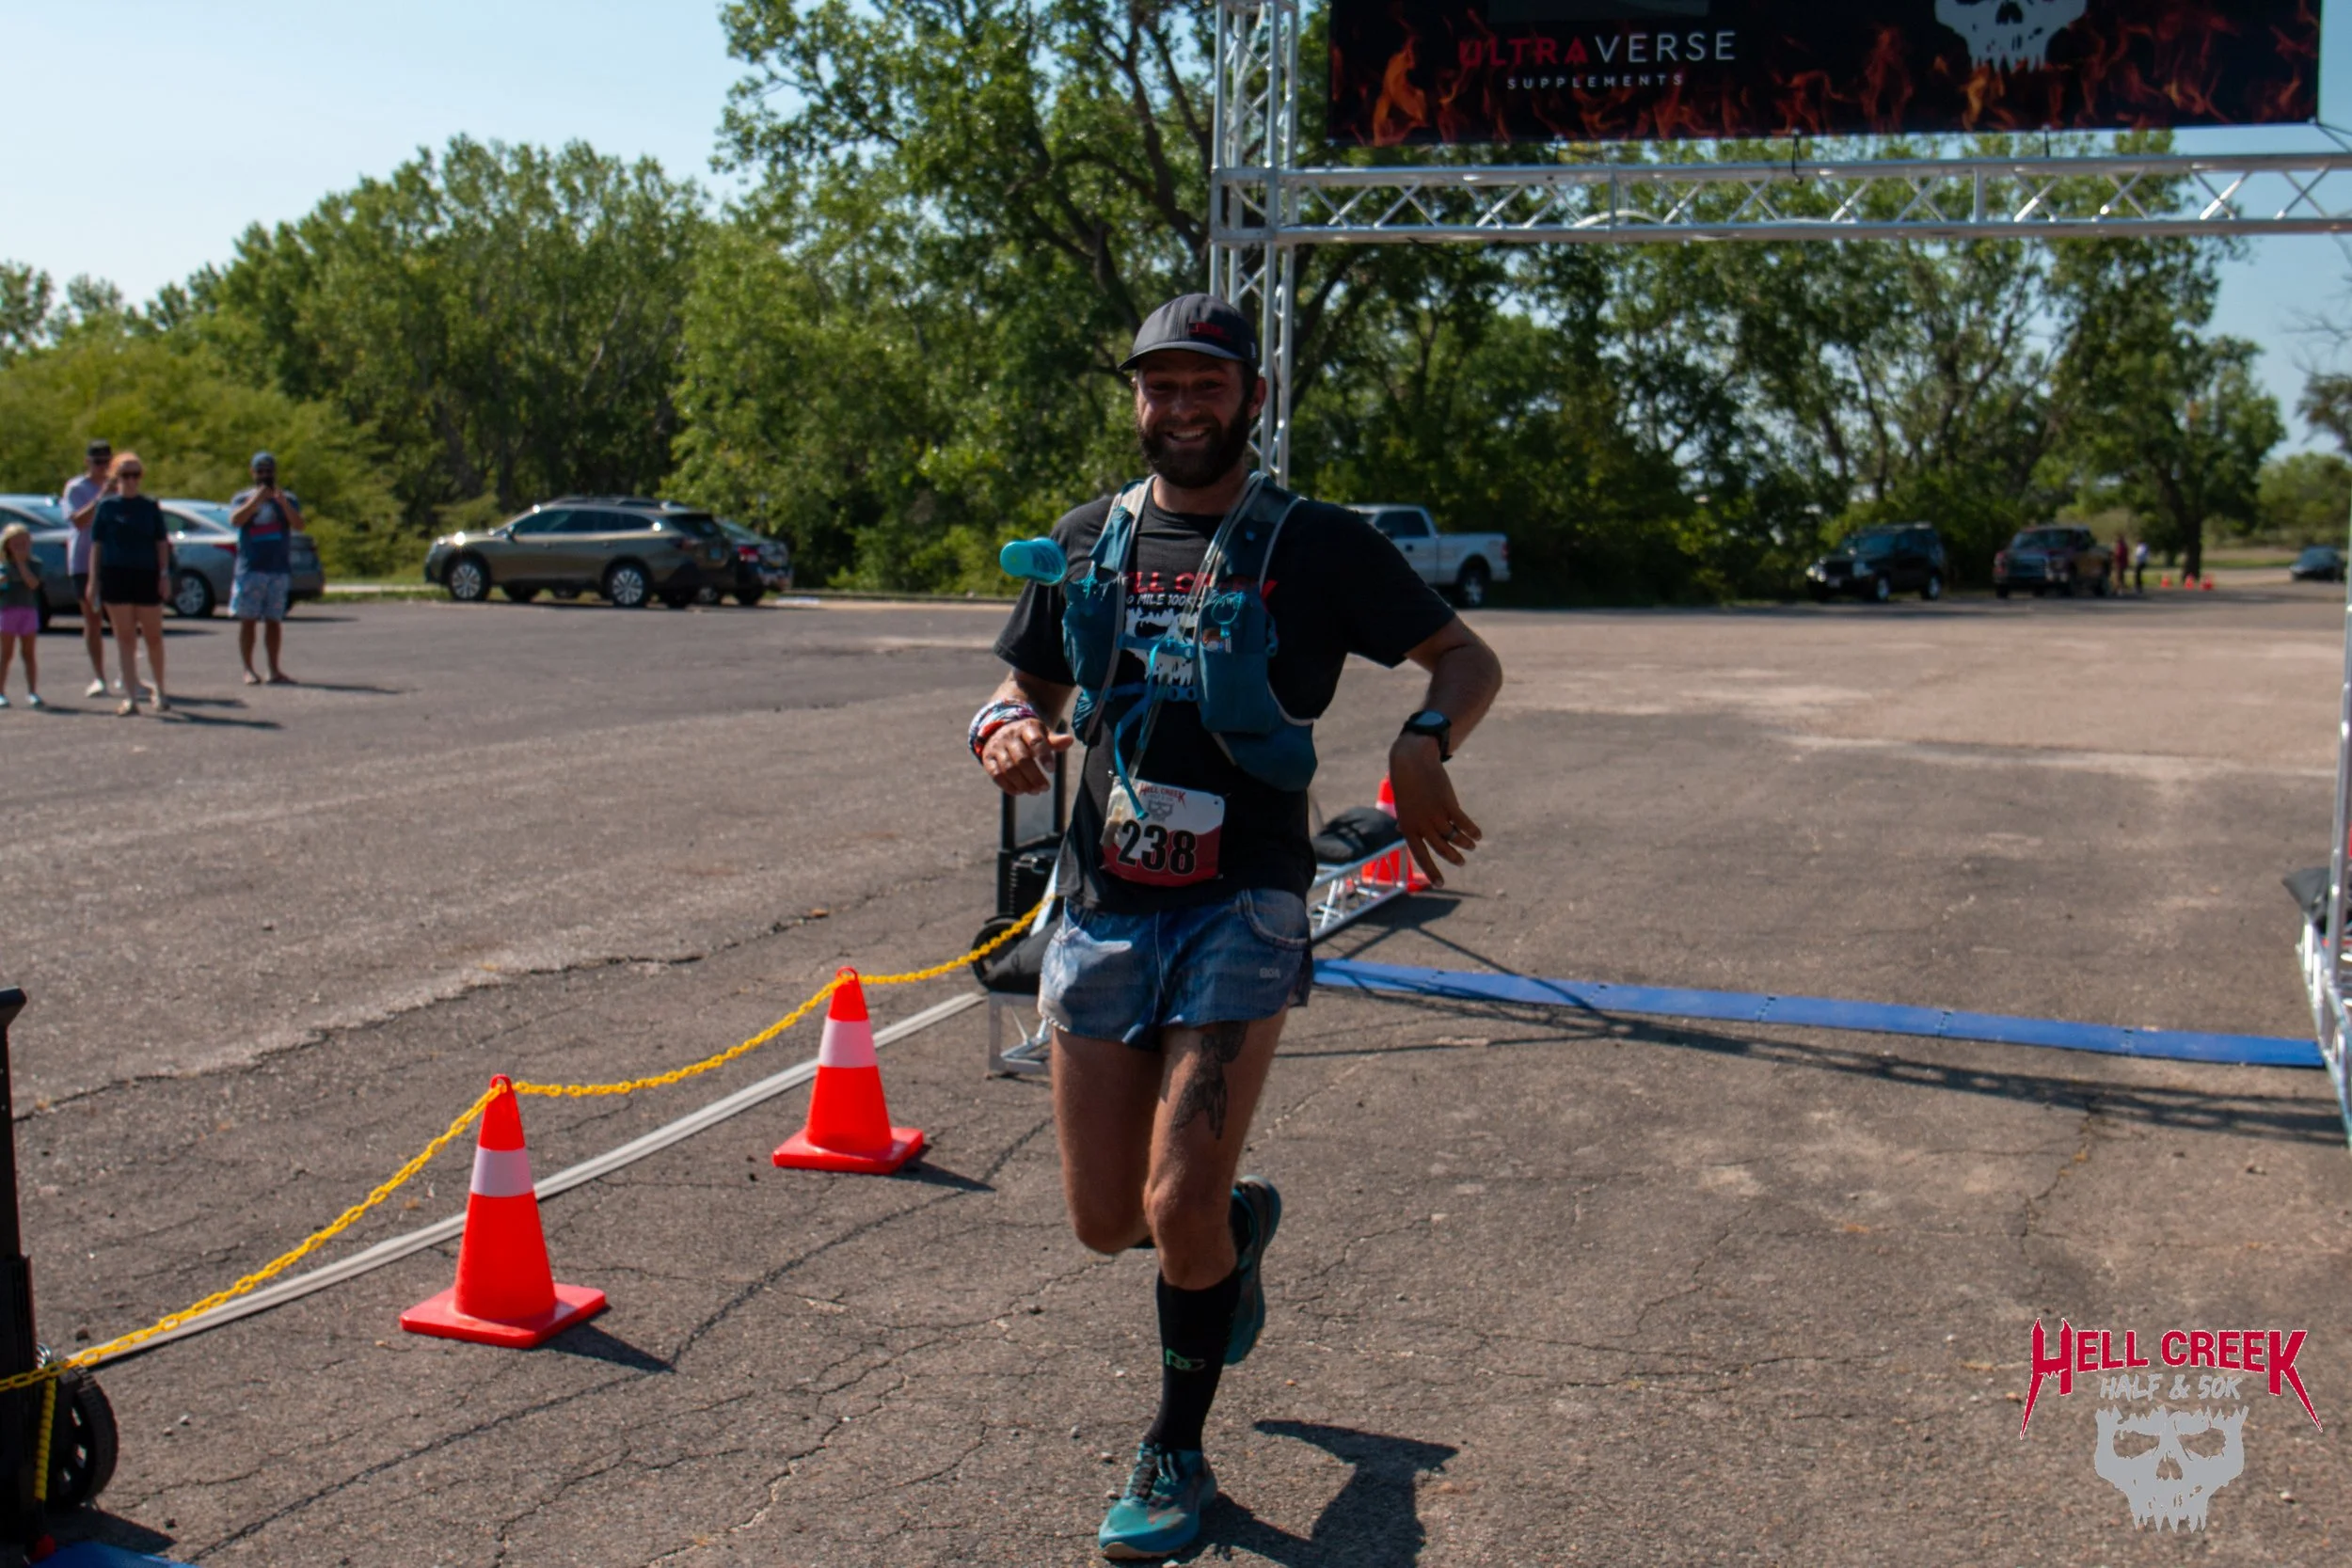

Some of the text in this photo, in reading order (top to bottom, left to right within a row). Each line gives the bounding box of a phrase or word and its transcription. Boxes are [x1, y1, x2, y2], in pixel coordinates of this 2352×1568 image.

[1457, 31, 1737, 68] ULTRAVERSE
[1506, 73, 1684, 90] SUPPLEMENTS
[1136, 594, 1166, 606] MILE
[1117, 819, 1197, 877] 238
